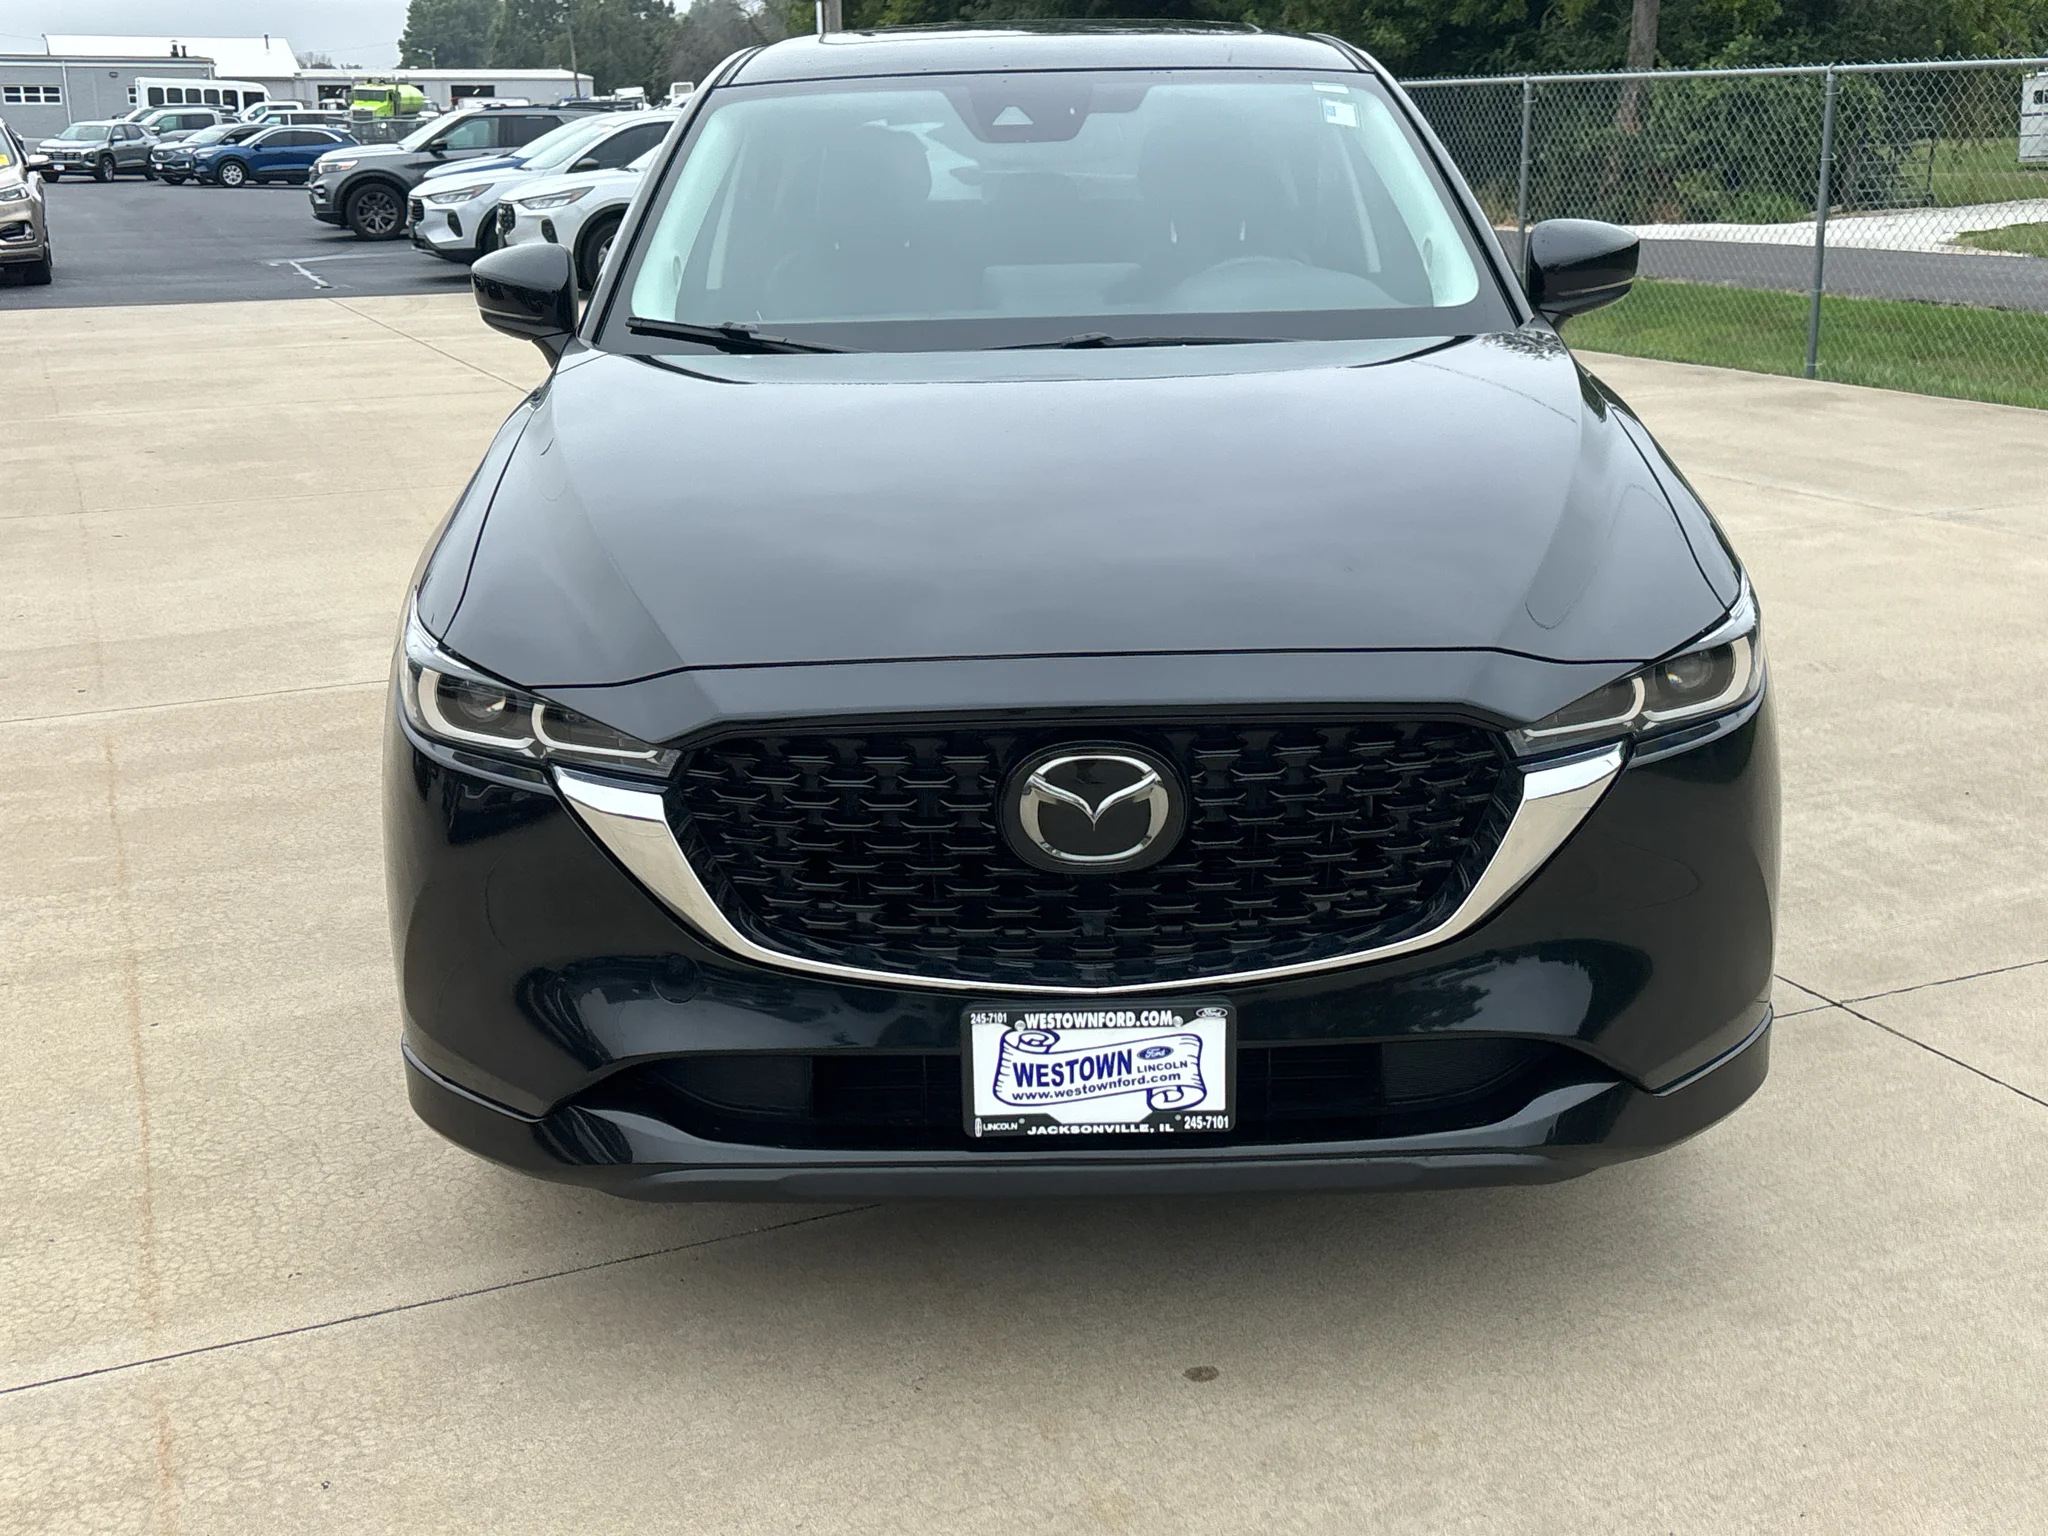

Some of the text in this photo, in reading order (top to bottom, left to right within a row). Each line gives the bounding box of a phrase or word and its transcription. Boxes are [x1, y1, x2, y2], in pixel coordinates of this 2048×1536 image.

[970, 1012, 1008, 1025] 245-7101
[1023, 1010, 1173, 1029] WESTOWNFORD.COM
[1012, 1049, 1132, 1088] WESTOWN
[1136, 1060, 1188, 1074] LINCOLN
[1011, 1072, 1182, 1101] www.westownford.com
[983, 1121, 1018, 1131] LINCOLN
[1027, 1122, 1175, 1135] JACKSONVILLE, IL
[1184, 1115, 1229, 1130] 245-7101
